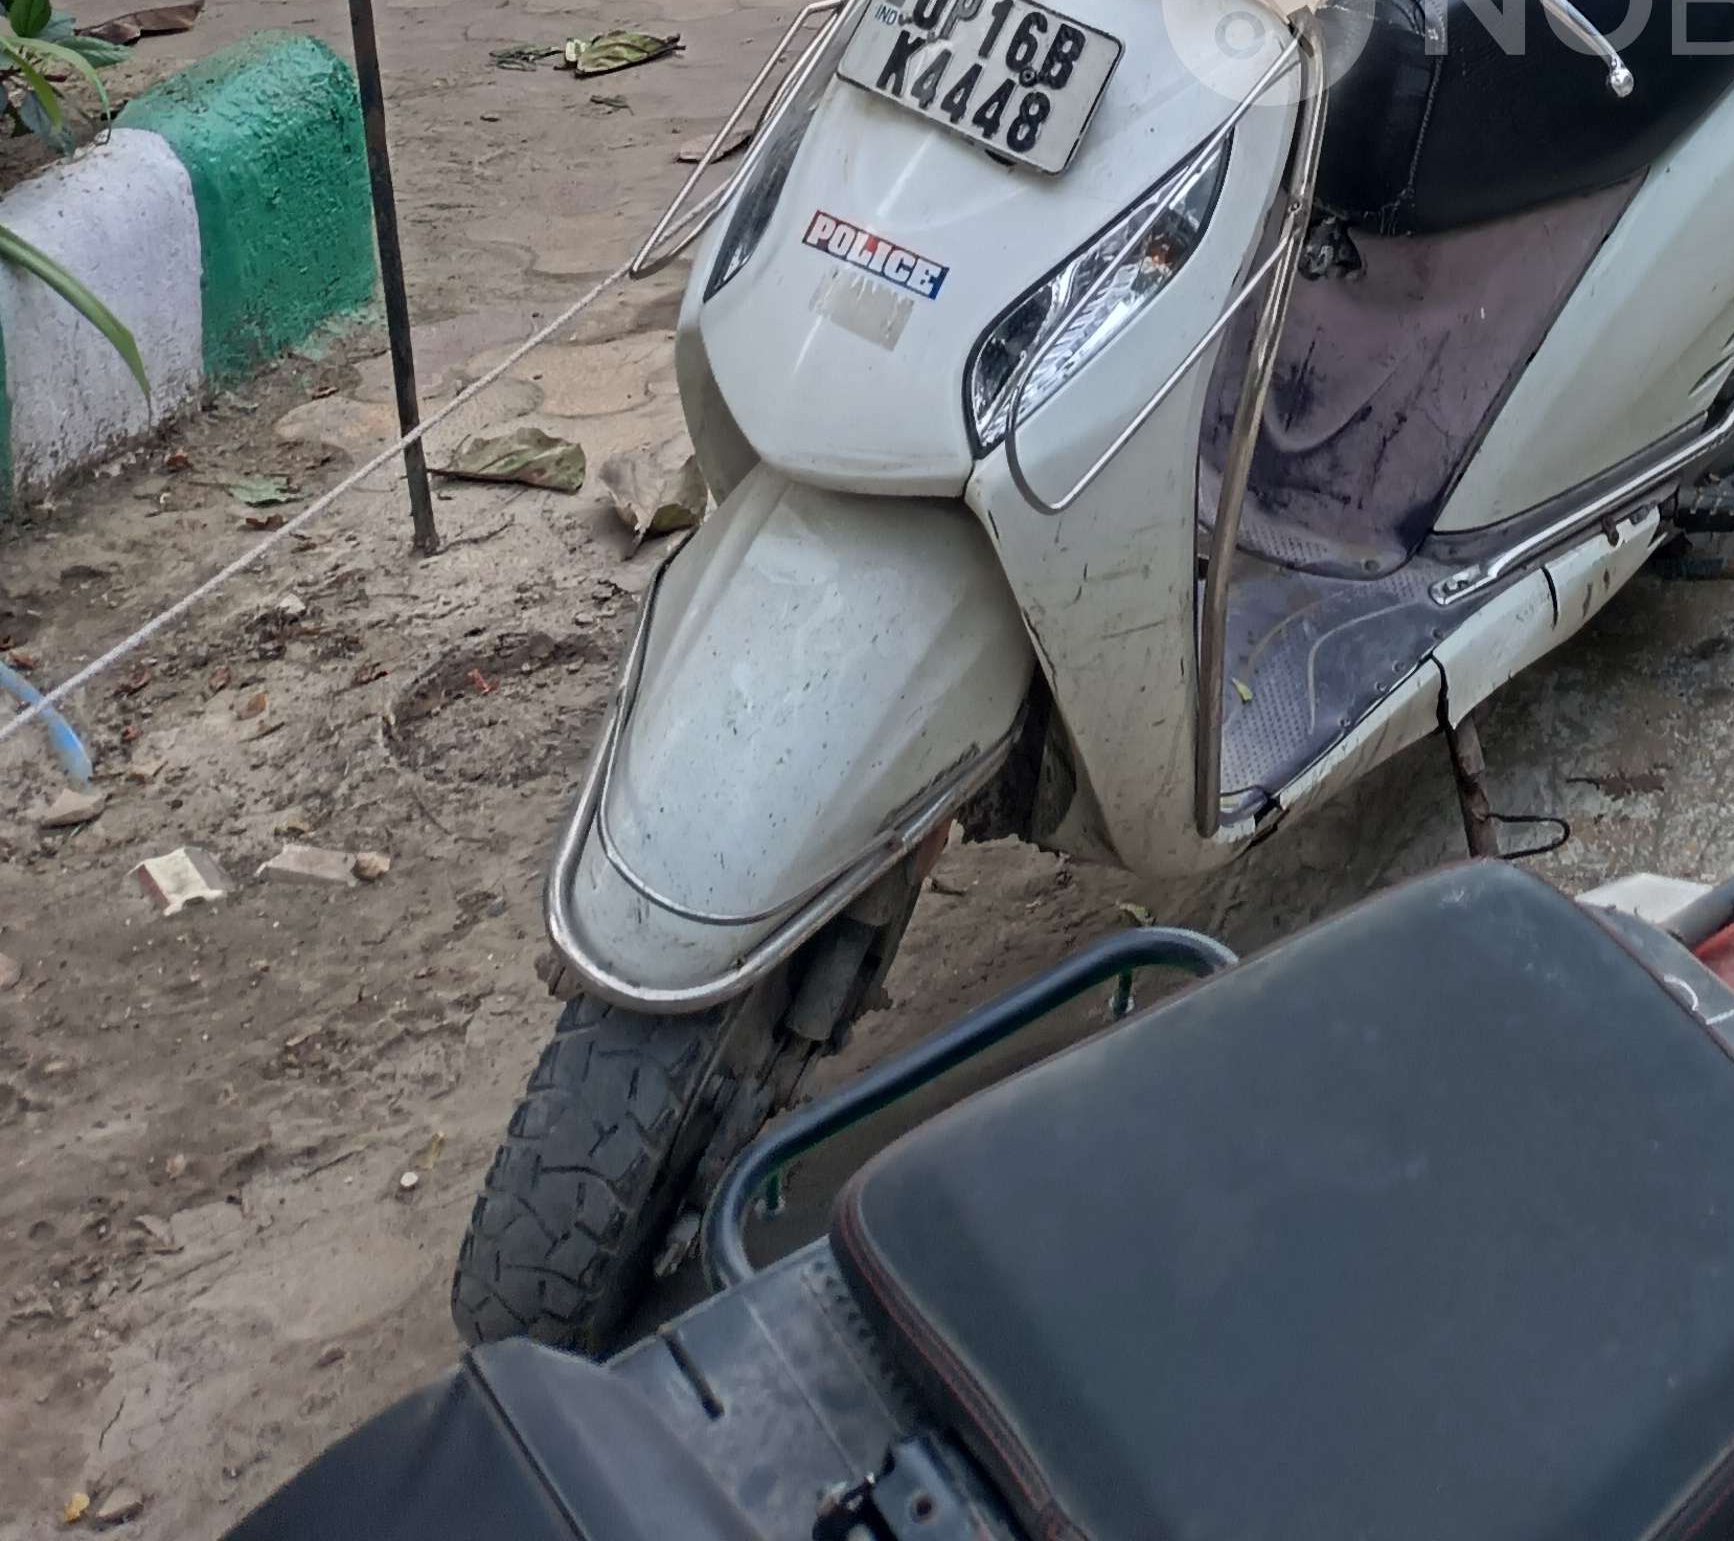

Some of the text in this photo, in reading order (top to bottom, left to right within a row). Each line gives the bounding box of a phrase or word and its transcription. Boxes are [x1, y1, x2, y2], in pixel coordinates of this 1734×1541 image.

[874, 3, 899, 26] IND
[875, 29, 1051, 152] K4448
[807, 213, 943, 294] POLICE
